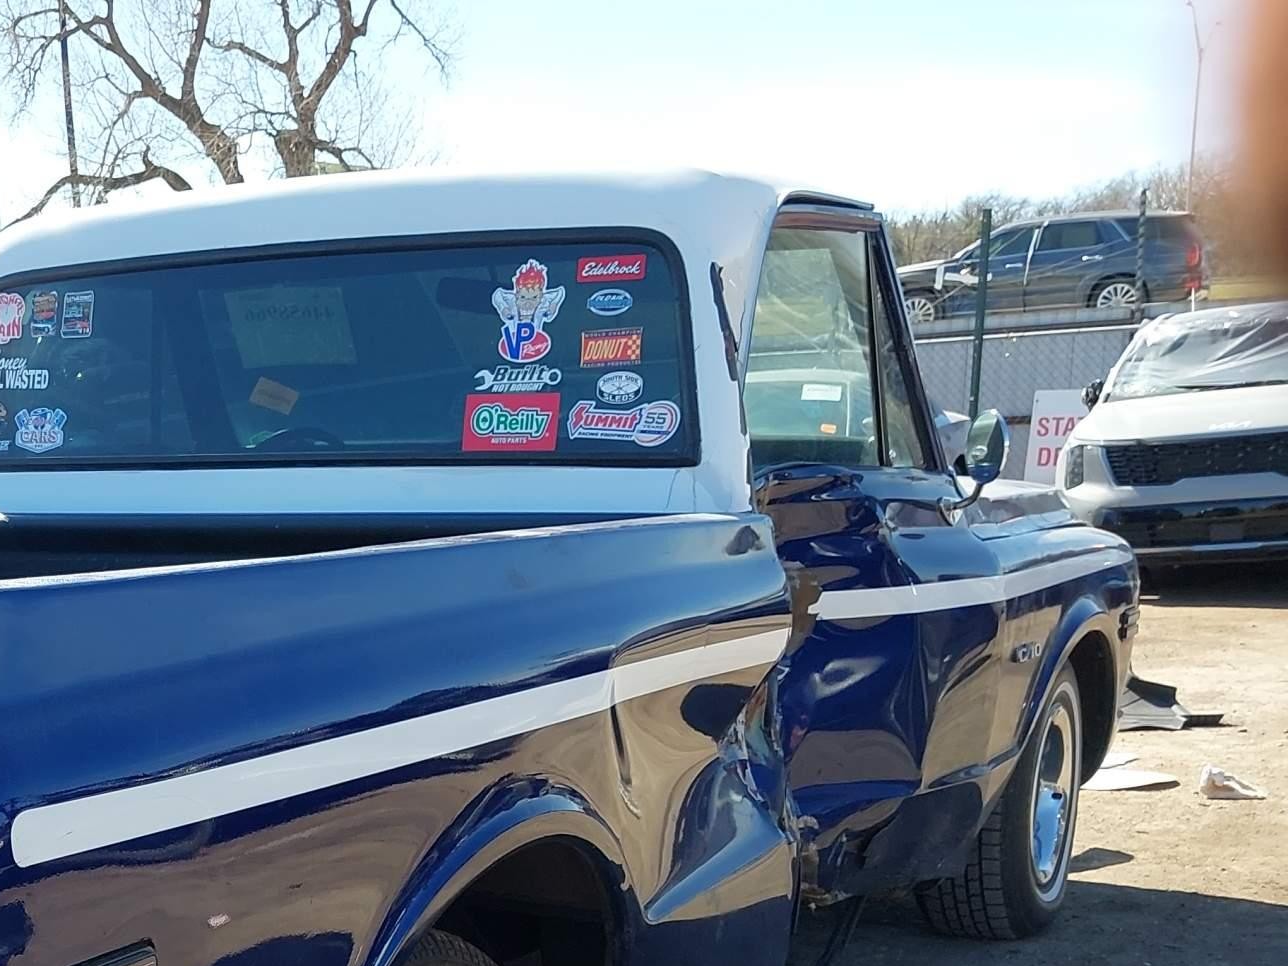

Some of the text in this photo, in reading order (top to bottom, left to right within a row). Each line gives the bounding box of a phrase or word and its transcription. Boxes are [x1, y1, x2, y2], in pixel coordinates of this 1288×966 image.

[581, 260, 641, 277] Edelbrock
[503, 322, 536, 360] VP
[583, 337, 629, 361] DONUT
[5, 369, 49, 389] WASTED
[492, 364, 549, 382] Built
[492, 382, 544, 393] NOT BOUGHT
[603, 392, 636, 402] SLEDS
[475, 405, 547, 435] O'Reilly
[644, 411, 669, 425] 55
[1037, 416, 1083, 437] STA
[22, 430, 58, 444] CARS
